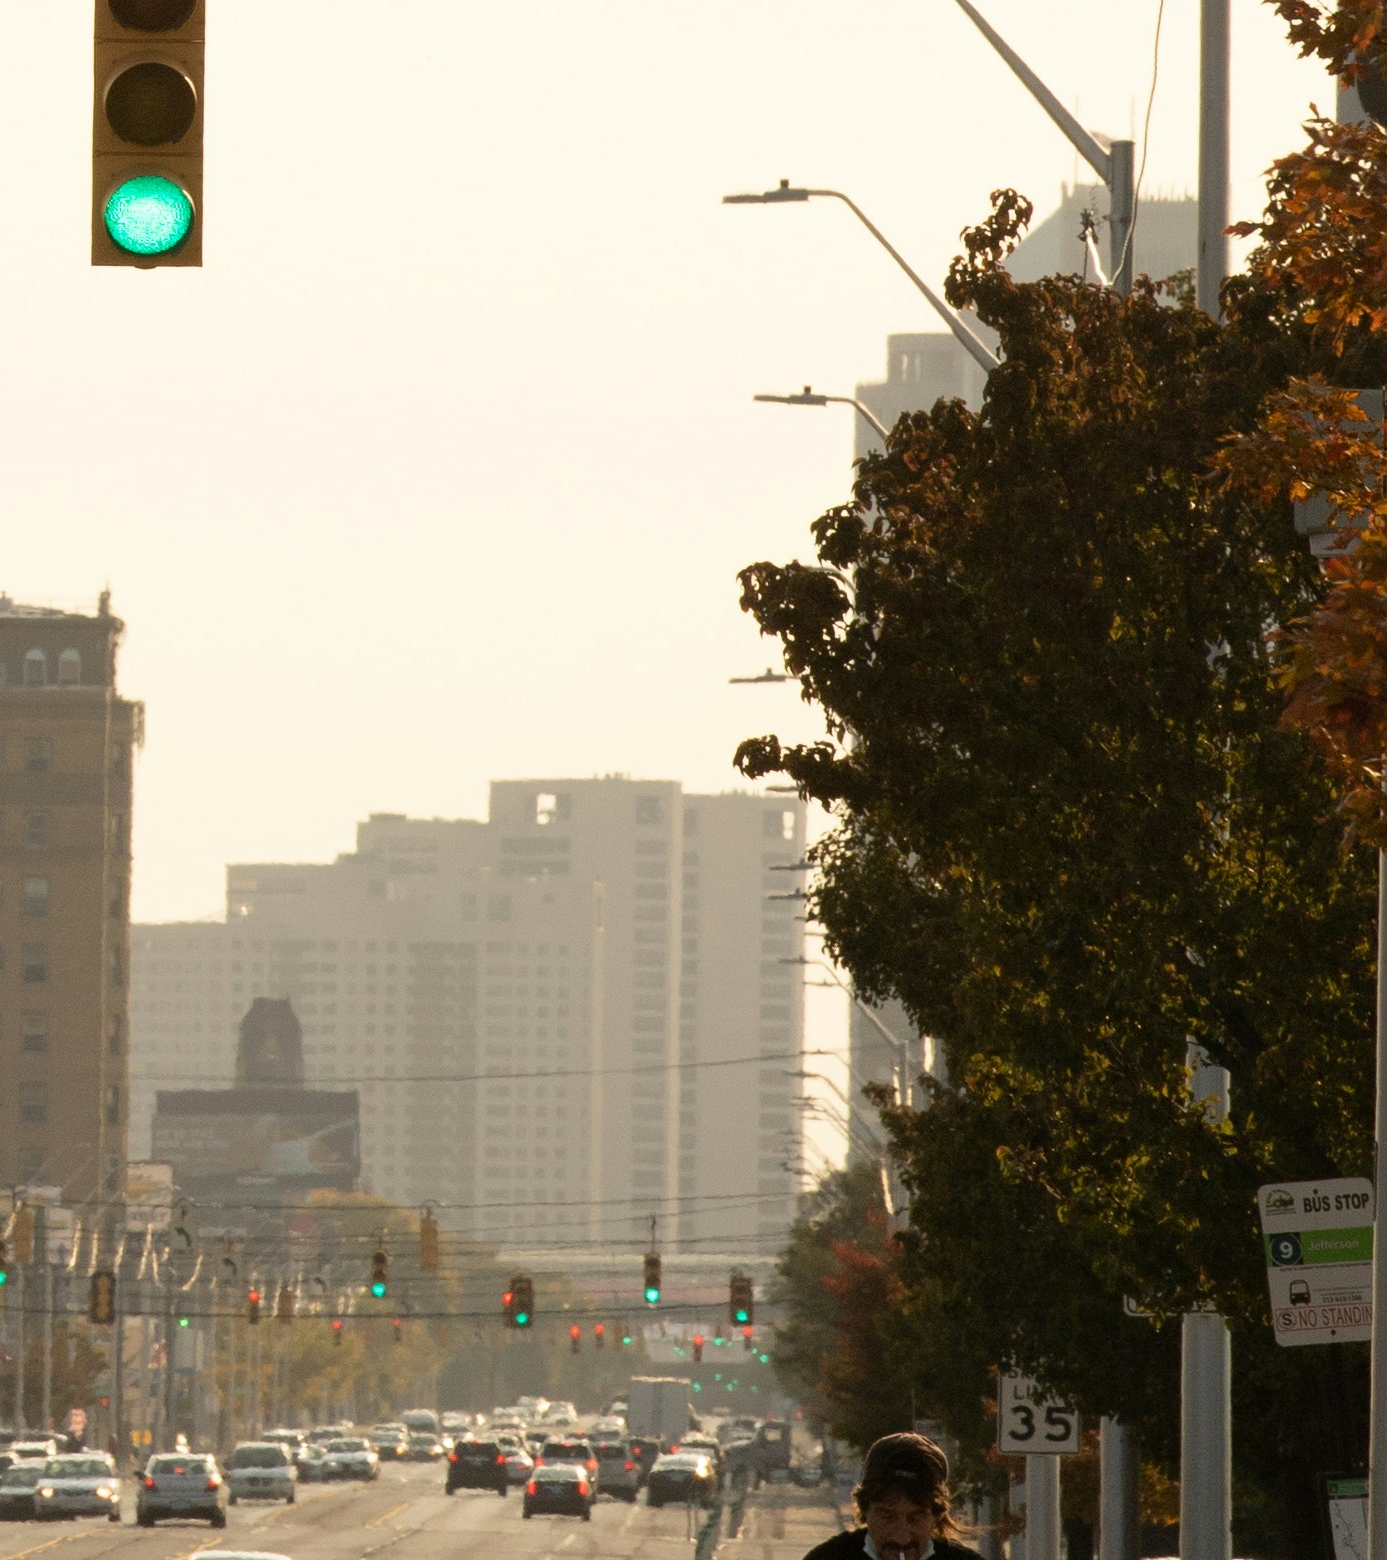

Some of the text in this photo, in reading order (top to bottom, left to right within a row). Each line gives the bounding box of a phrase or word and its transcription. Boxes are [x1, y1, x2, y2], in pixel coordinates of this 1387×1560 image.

[1303, 1195, 1331, 1213] BUS
[1334, 1192, 1370, 1211] STOP
[1279, 1238, 1359, 1259] 9 Jefferson
[1298, 1308, 1317, 1328] NO
[1321, 1305, 1373, 1326] STANDIN
[1008, 1404, 1072, 1442] 35
